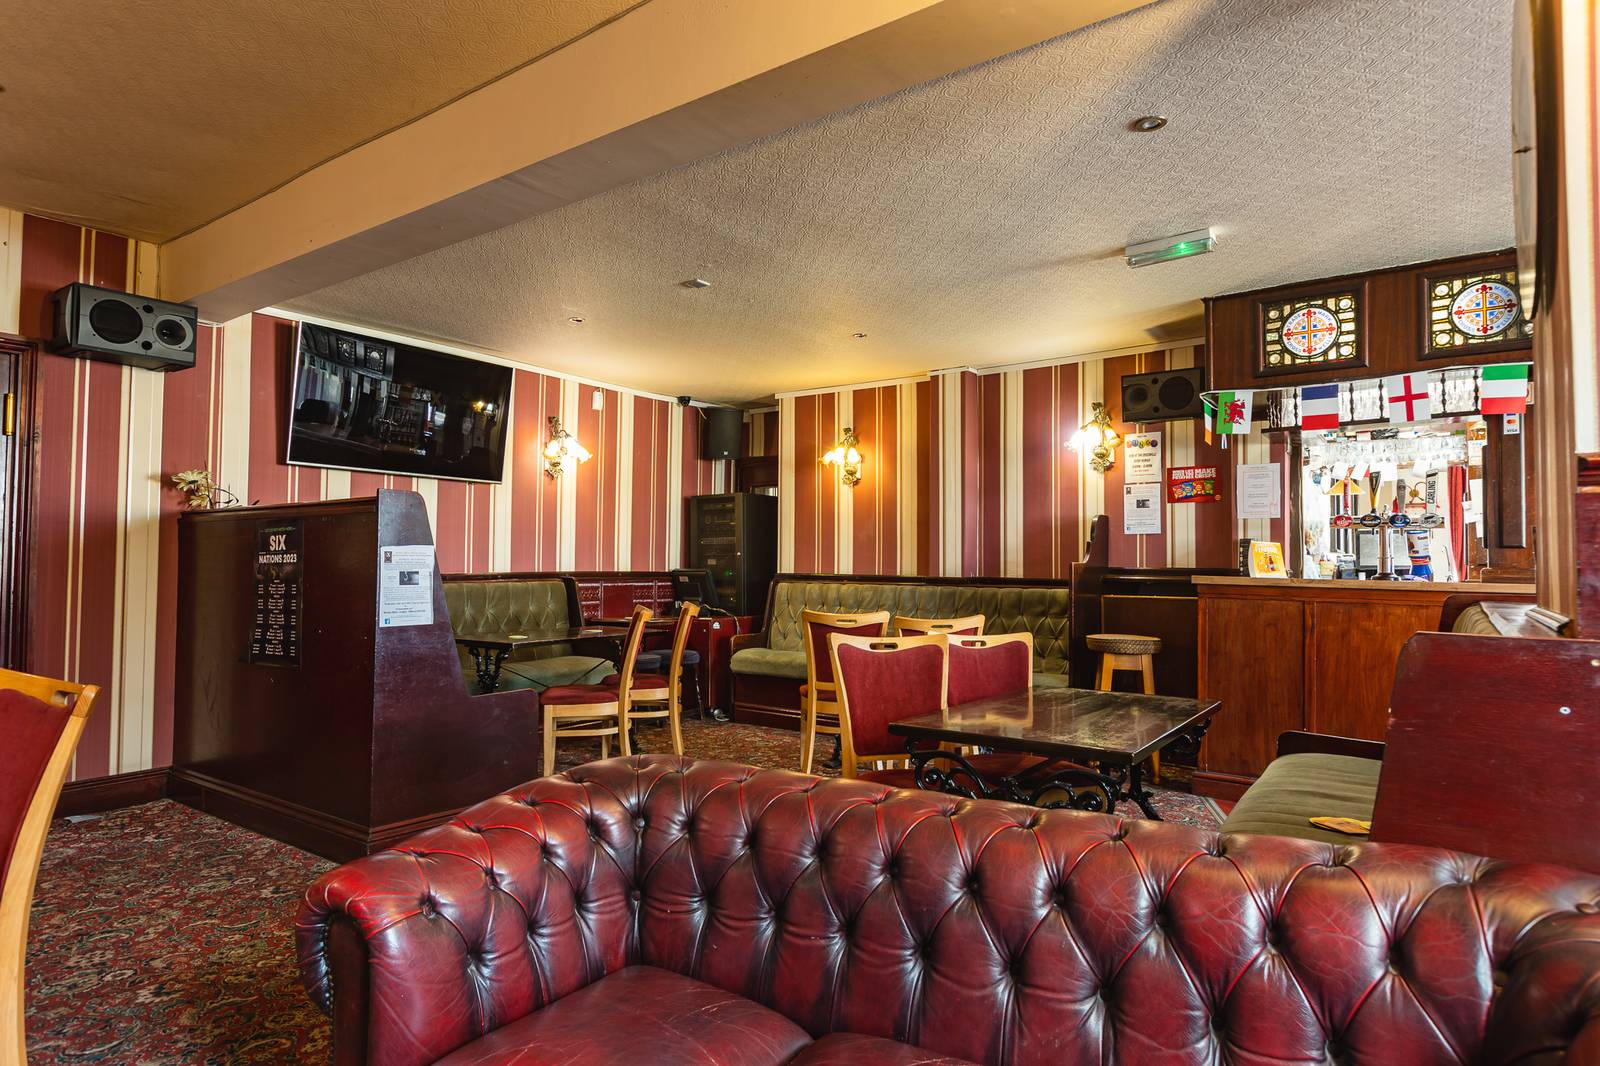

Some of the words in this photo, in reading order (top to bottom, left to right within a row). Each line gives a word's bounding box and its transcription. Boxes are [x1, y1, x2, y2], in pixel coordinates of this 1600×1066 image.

[1494, 285, 1512, 298] MARK
[1286, 313, 1301, 328] TRADE
[1317, 310, 1331, 322] MARK
[1427, 480, 1436, 504] CARLING
[270, 534, 287, 551] SIX
[258, 554, 282, 564] NATIONS
[283, 553, 297, 563] 2023
